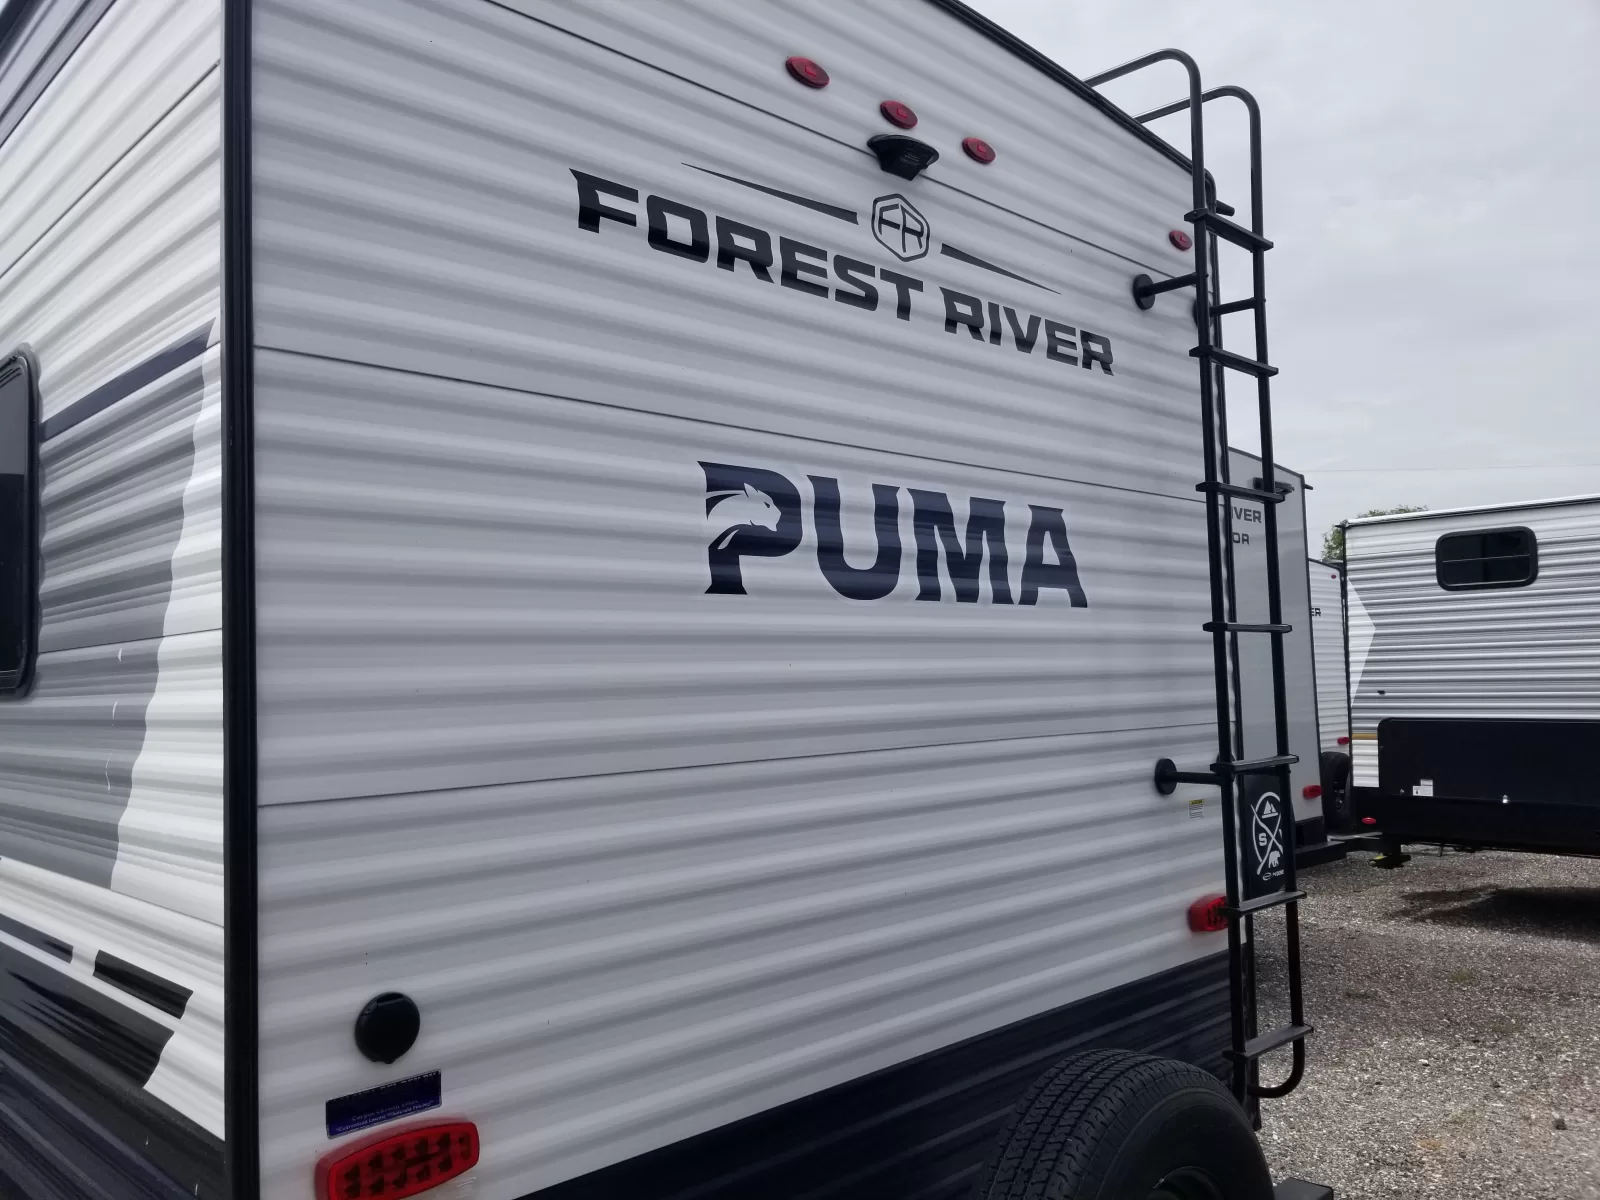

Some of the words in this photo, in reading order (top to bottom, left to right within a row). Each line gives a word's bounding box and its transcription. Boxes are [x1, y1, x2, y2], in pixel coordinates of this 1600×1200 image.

[569, 168, 924, 322] FOREST
[939, 286, 1114, 376] RIVER
[697, 460, 1088, 609] PUMA
